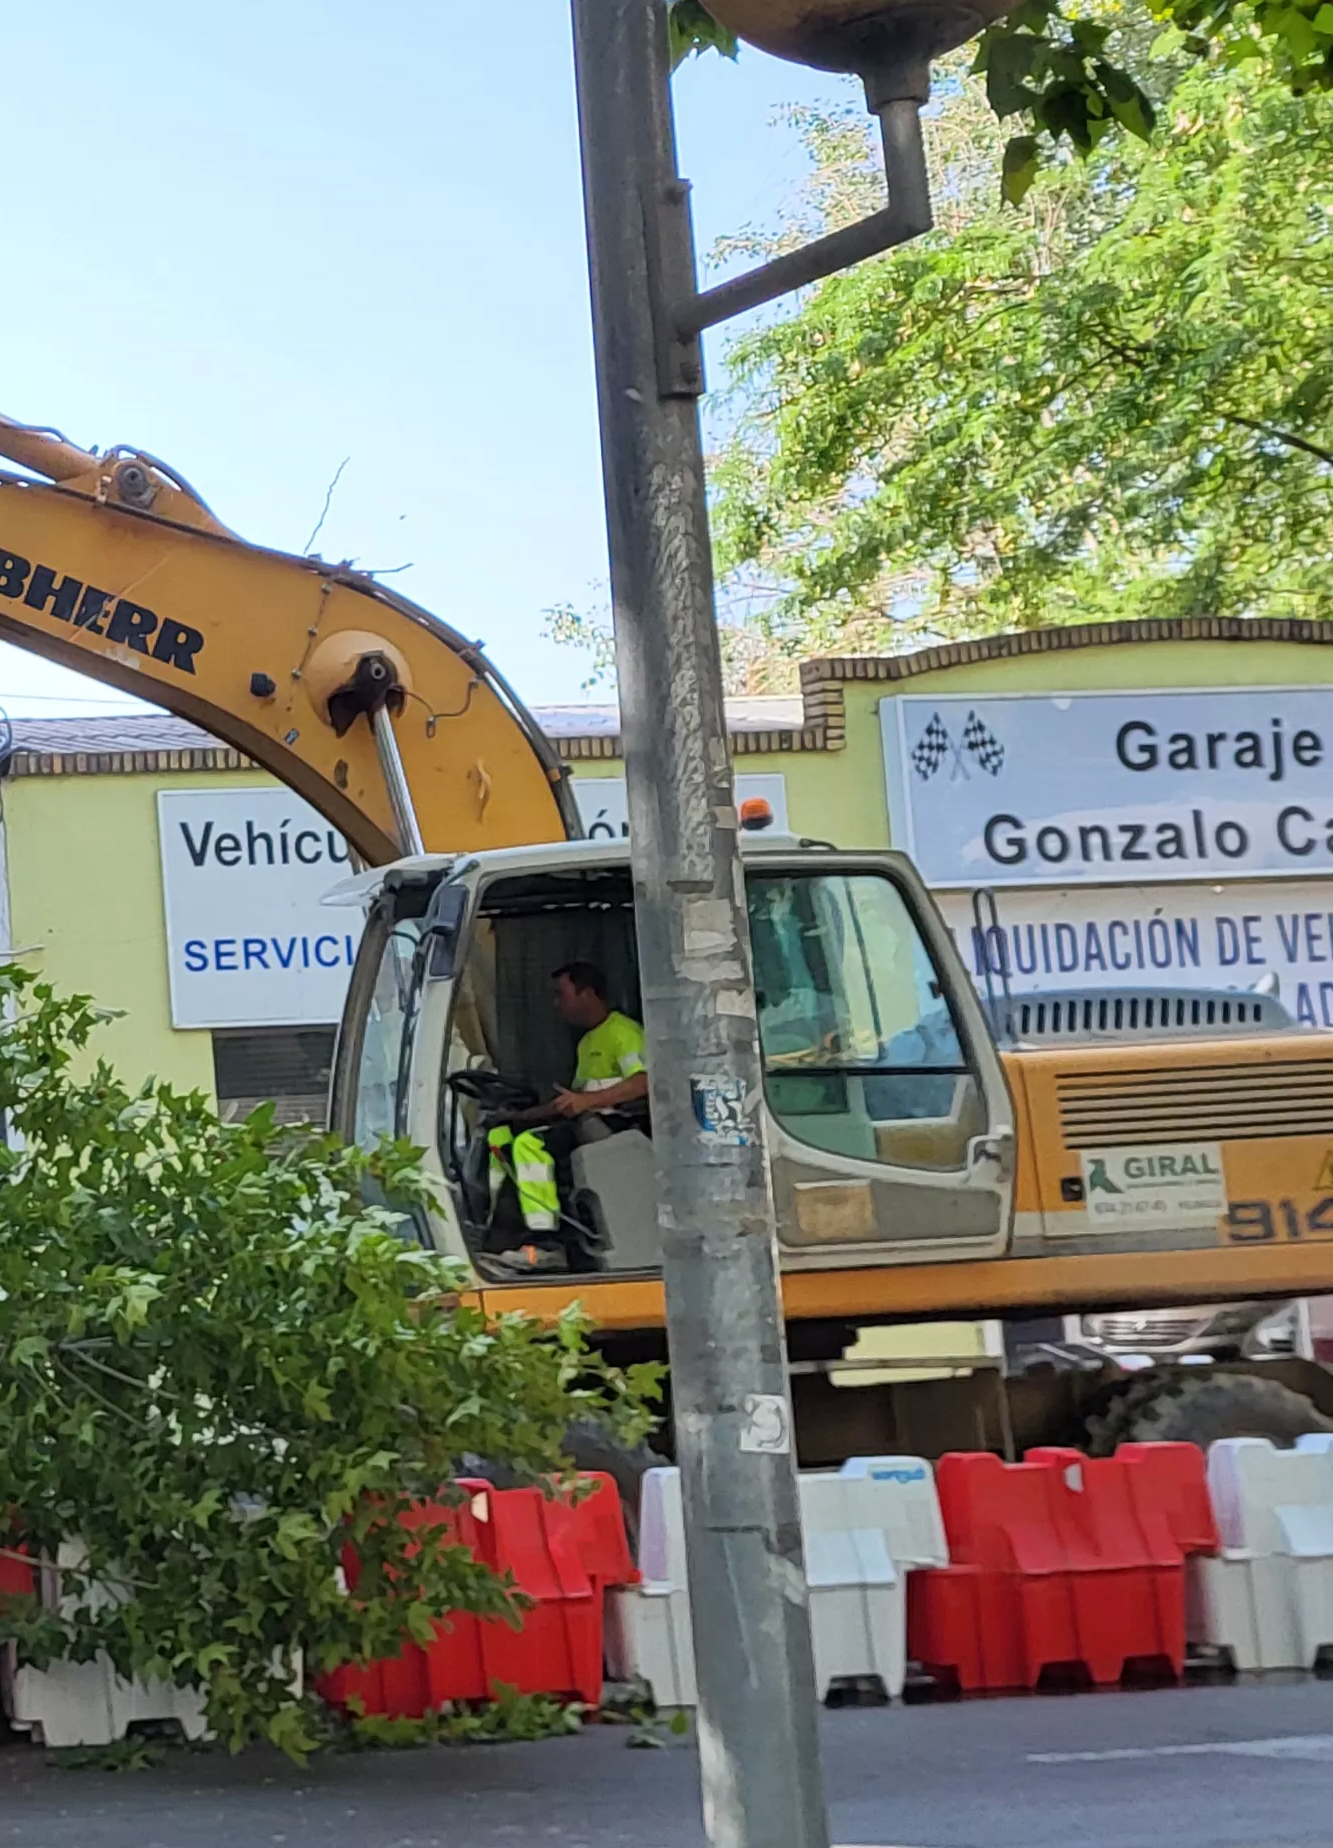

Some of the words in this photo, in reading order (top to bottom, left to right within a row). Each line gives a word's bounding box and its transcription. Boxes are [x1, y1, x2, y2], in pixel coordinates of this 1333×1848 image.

[1116, 717, 1324, 781] Garaje
[179, 818, 349, 867] Vehícu
[984, 809, 1250, 865] Gonzalo
[184, 935, 354, 973] SERVICI
[971, 908, 1201, 977] IQUIDACIÓN
[1216, 916, 1266, 967] DE
[1275, 912, 1333, 963] VE
[1124, 1153, 1220, 1179] GIRAL
